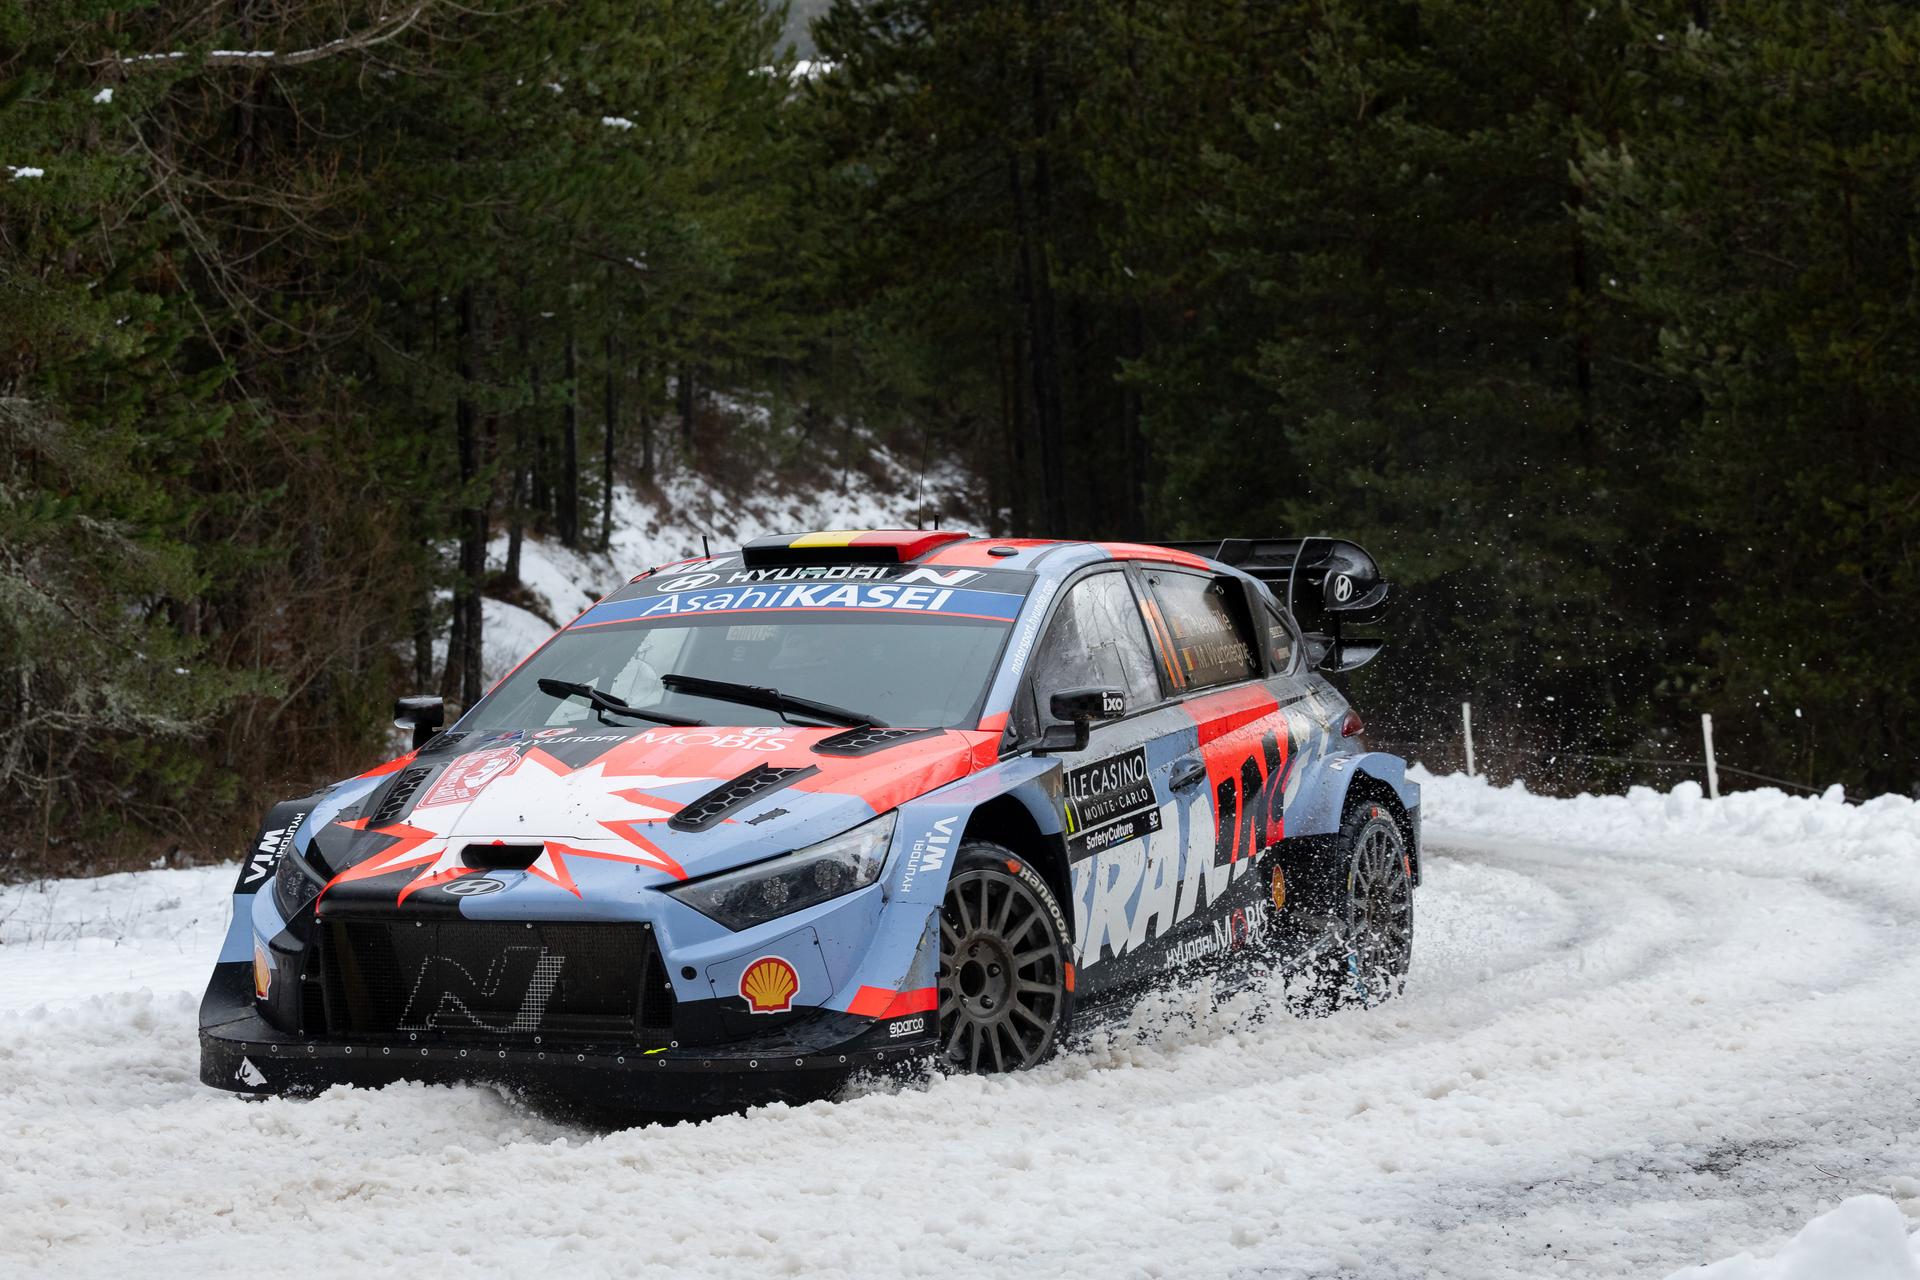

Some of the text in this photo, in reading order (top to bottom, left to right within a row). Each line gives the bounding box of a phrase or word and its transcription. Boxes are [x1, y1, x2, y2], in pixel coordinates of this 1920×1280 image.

[726, 566, 889, 585] HYUNDAI
[639, 584, 954, 617] AsahiKASEI
[510, 731, 795, 751] HYUNDAI MOBIS
[1073, 755, 1145, 802] LE CASINO
[1149, 811, 1160, 826] SC
[274, 812, 306, 858] HYUNDAI
[1086, 822, 1134, 851] SafetyCulture
[900, 839, 926, 893] HYUNDAI
[889, 1018, 924, 1038] sparco
